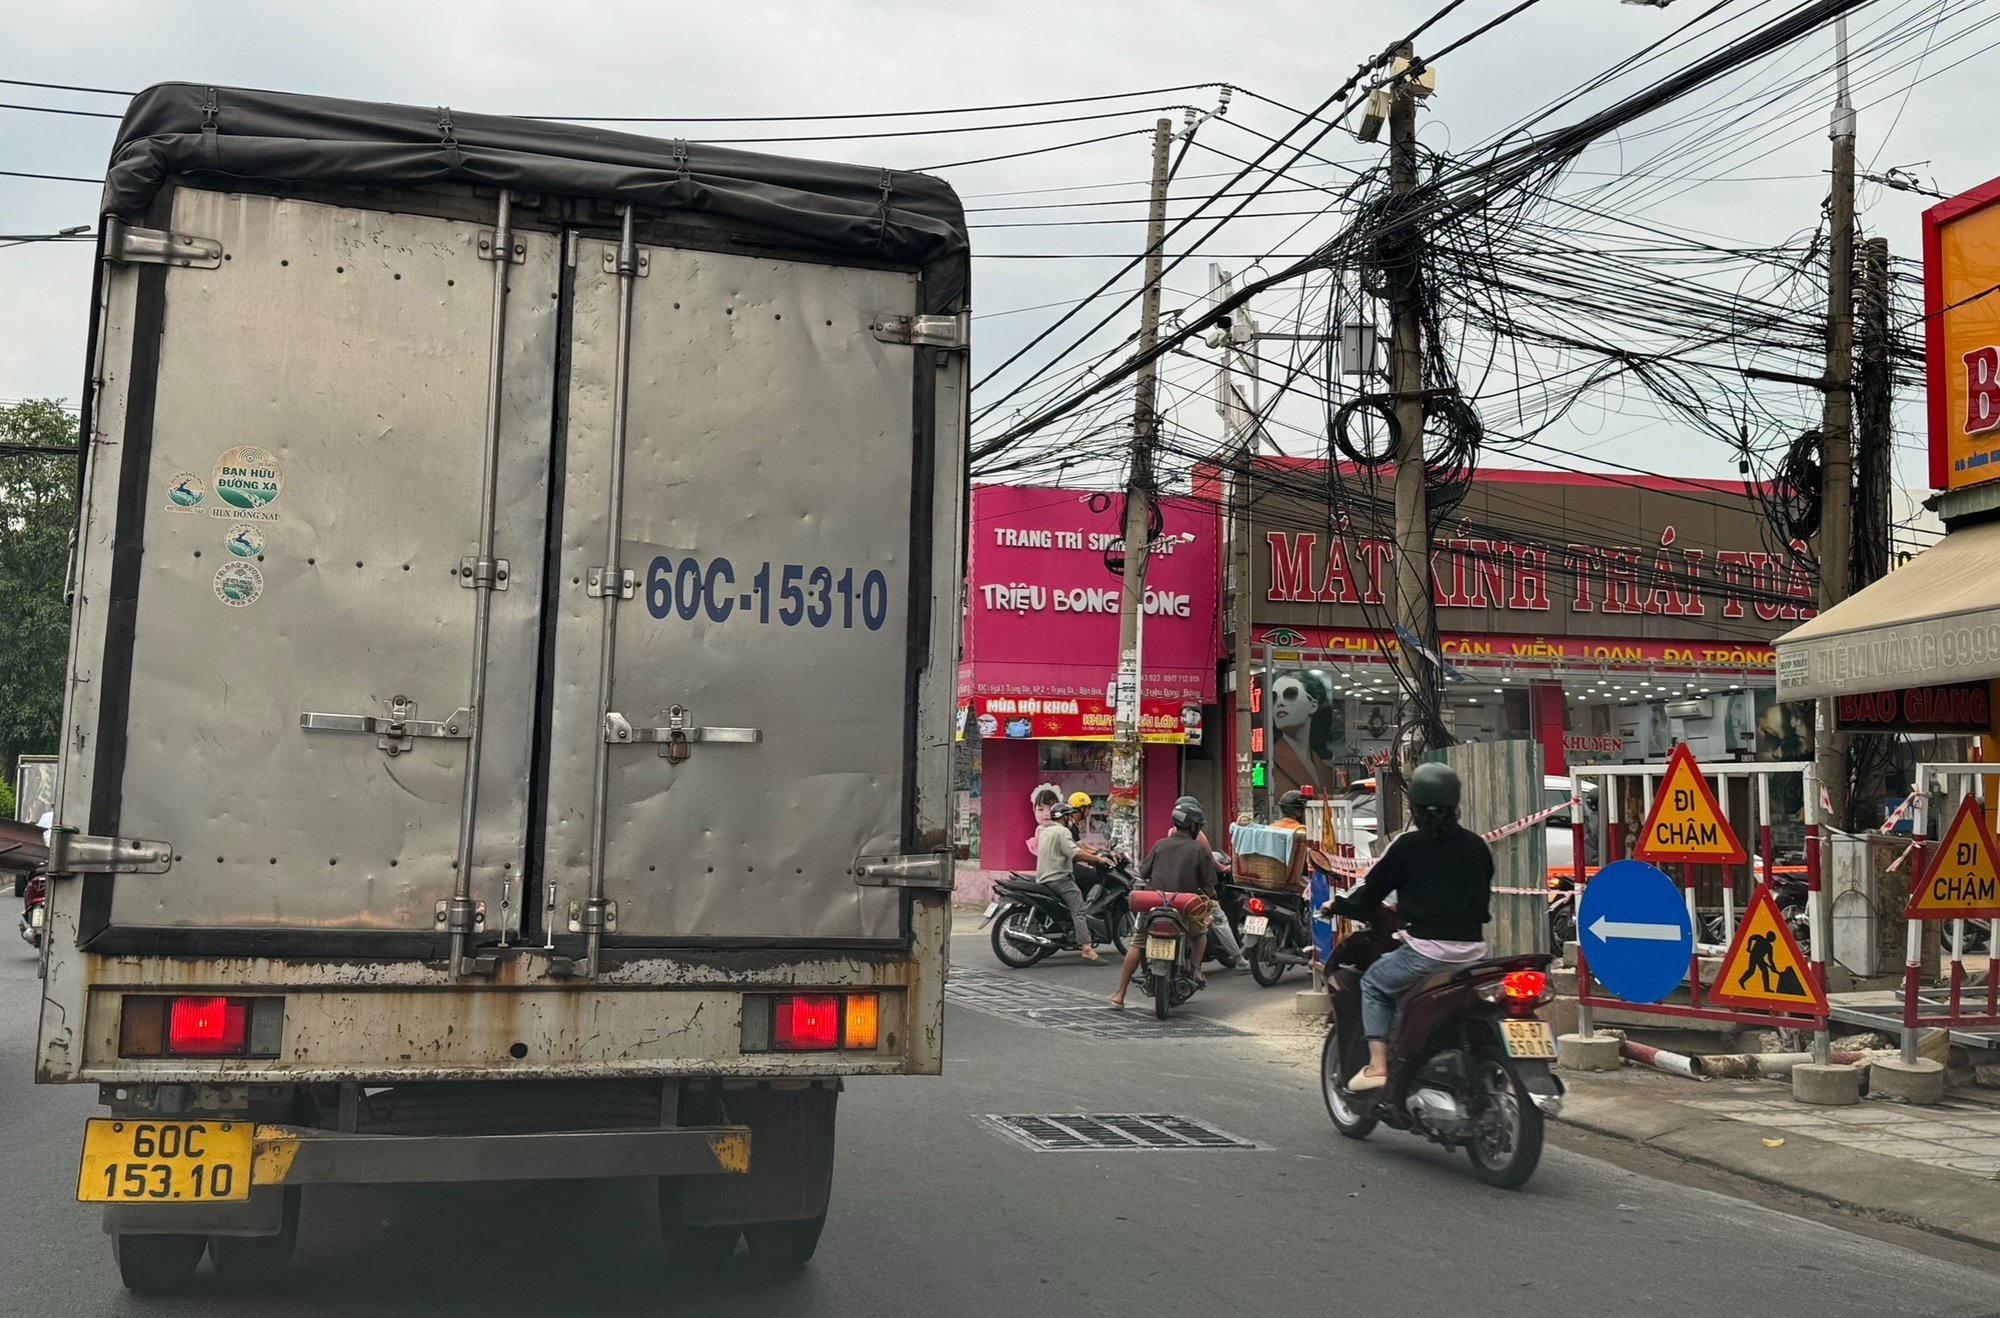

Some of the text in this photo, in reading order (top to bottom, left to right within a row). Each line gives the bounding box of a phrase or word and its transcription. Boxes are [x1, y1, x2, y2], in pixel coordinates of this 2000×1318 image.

[218, 478, 277, 491] ĐƯỜNG XA
[222, 467, 247, 478] BẠN
[212, 509, 231, 518] HLX
[262, 512, 278, 520] NAI
[994, 528, 1052, 549] TRANG
[1055, 528, 1084, 550] TRÍ
[1564, 526, 1705, 616] THÁI
[646, 556, 888, 631] 60C-15310
[980, 582, 1047, 616] TRIỆU
[1053, 588, 1120, 614] BONG
[1143, 586, 1191, 618] ÓNG
[1815, 623, 2000, 688] TIỆM VÀNG 9999
[1082, 714, 1116, 726] KHUY
[1904, 688, 1988, 724] GIANG
[1674, 789, 1695, 812] ĐI
[1656, 817, 1718, 851] CHẬM
[1956, 842, 1978, 866] ĐI
[1933, 872, 1996, 906] CHẬM
[133, 1124, 206, 1158] 60C
[104, 1163, 233, 1198] 153.10
